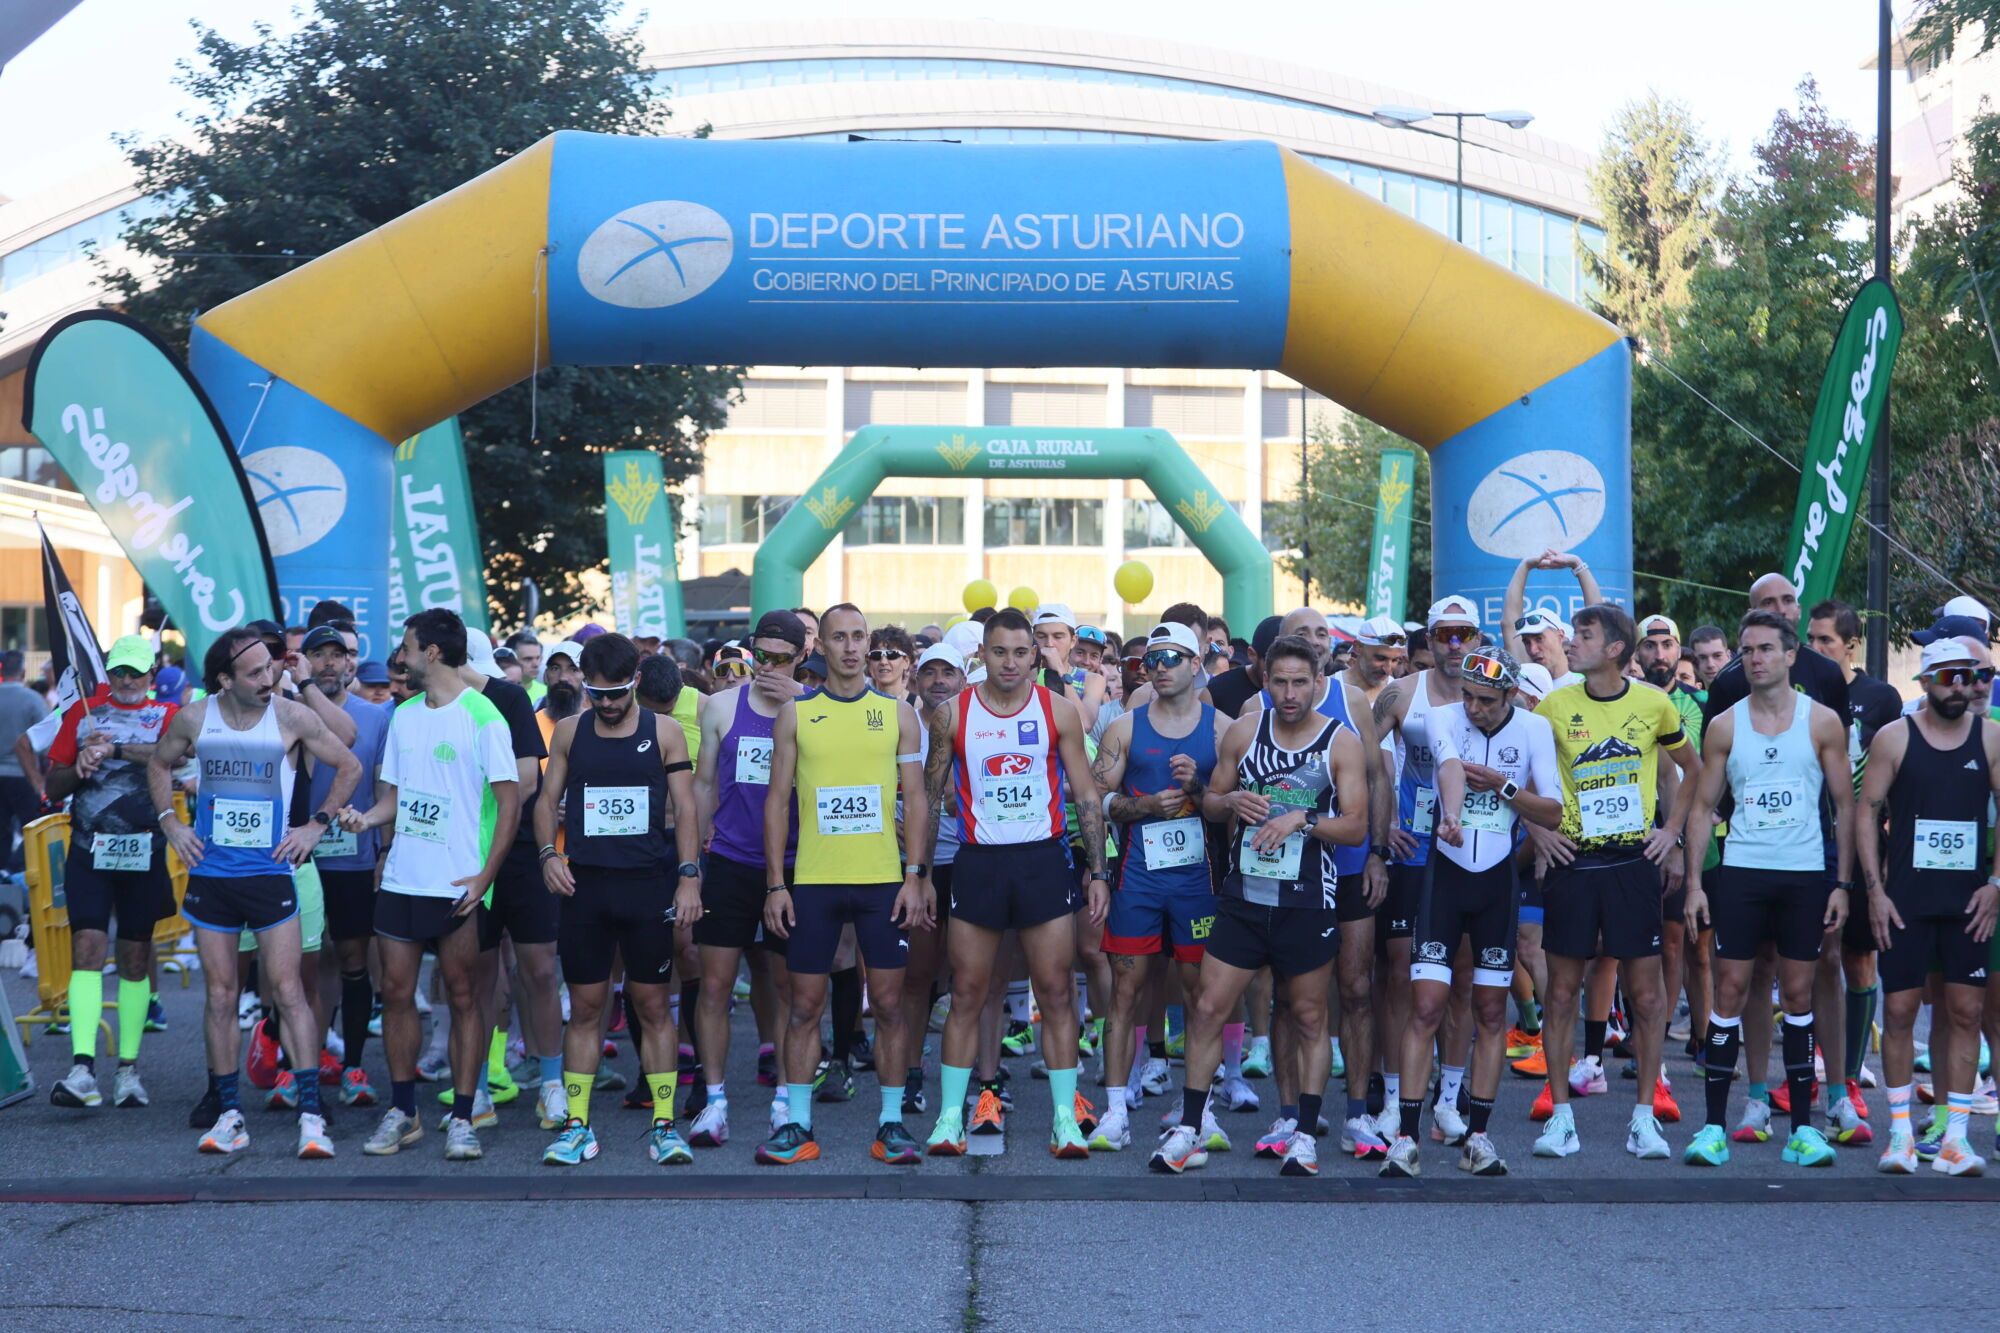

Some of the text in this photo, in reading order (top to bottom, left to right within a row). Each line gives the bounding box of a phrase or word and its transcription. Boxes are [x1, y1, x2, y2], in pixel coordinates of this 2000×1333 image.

[749, 212, 1244, 249] DEPORTE ASTURIANO
[753, 268, 1234, 292] GOBIERNO DEL PRINCIPADO DE ASTURIAS
[986, 439, 1099, 456] CAJA RURAL
[988, 459, 1066, 469] DE ASTURIAS
[206, 759, 274, 779] CEACTIVO
[1572, 759, 1642, 781] senderos
[1264, 772, 1308, 788] RESTAURANTE
[997, 785, 1032, 803] 514
[1262, 784, 1318, 809] CEREZAL
[1464, 793, 1500, 811] 548
[1757, 790, 1793, 809] 450
[409, 800, 440, 821] 412
[598, 798, 635, 815] 353
[831, 796, 868, 814] 243
[1593, 796, 1629, 815] 259
[226, 811, 261, 828] 356
[840, 812, 876, 821] KUZMENKO
[107, 838, 140, 853] 218
[1162, 830, 1186, 848] 60
[1928, 832, 1965, 849] 565
[1257, 856, 1280, 864] ROMEO
